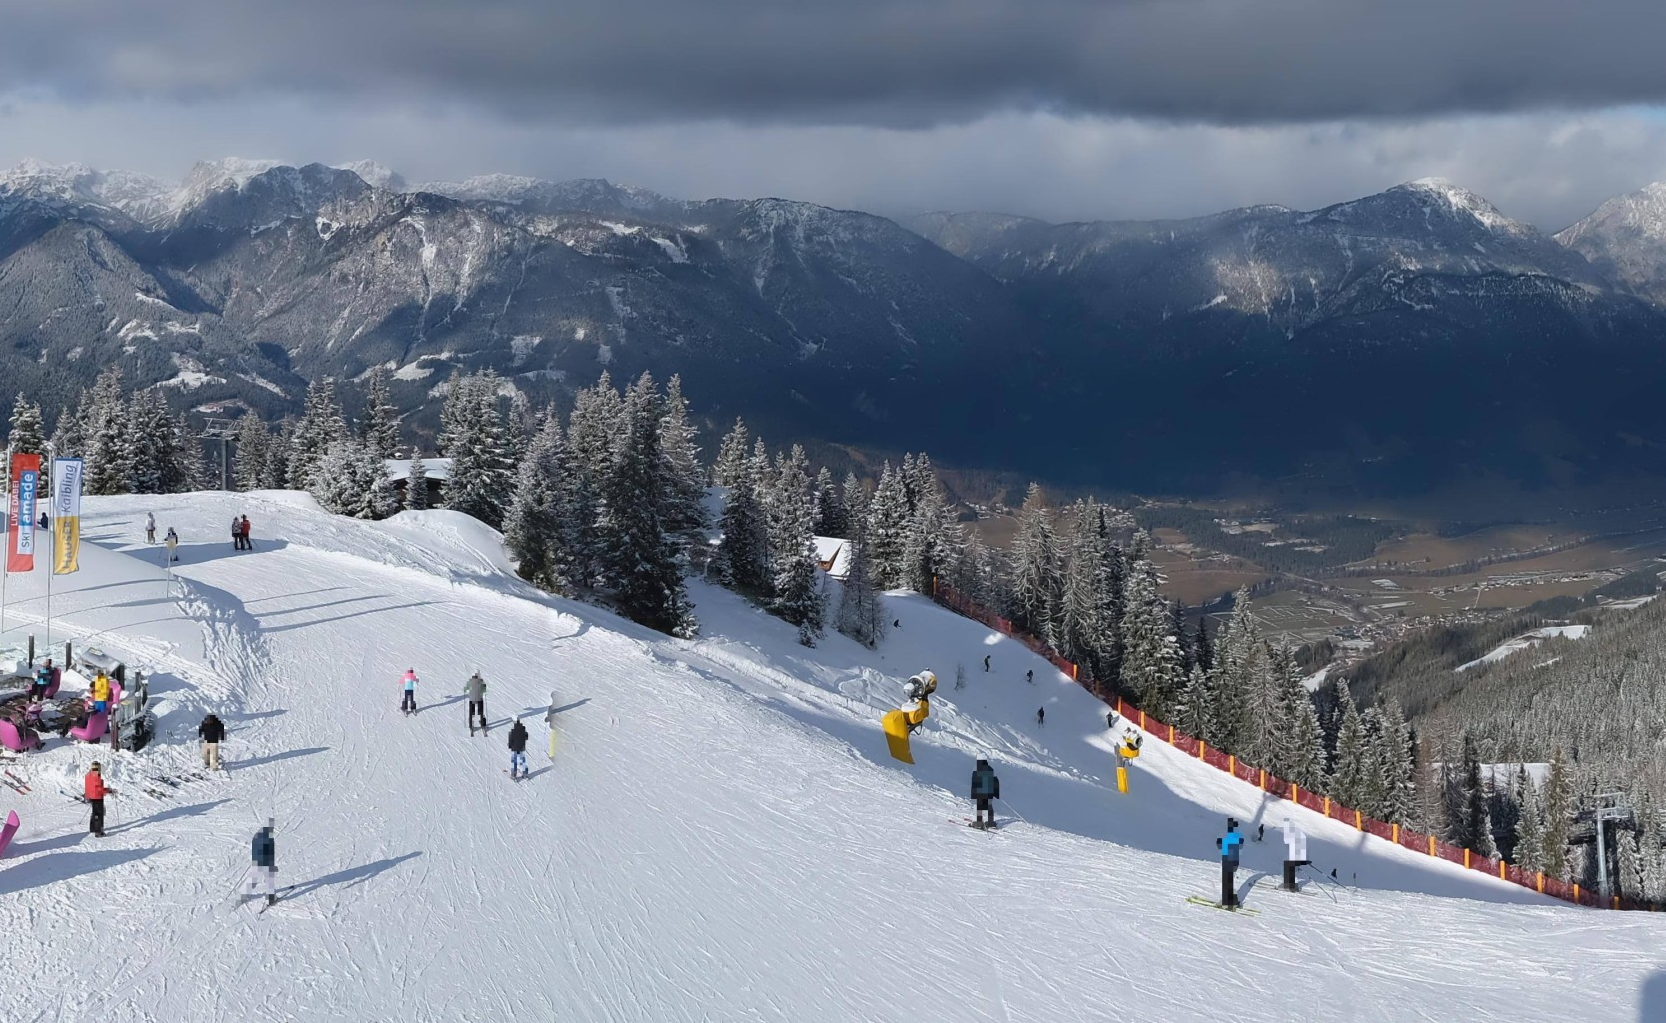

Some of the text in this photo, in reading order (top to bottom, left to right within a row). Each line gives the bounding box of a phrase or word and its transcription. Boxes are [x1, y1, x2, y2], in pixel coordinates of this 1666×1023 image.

[11, 480, 20, 526] LIVE DABEI
[61, 464, 77, 513] Kaibling
